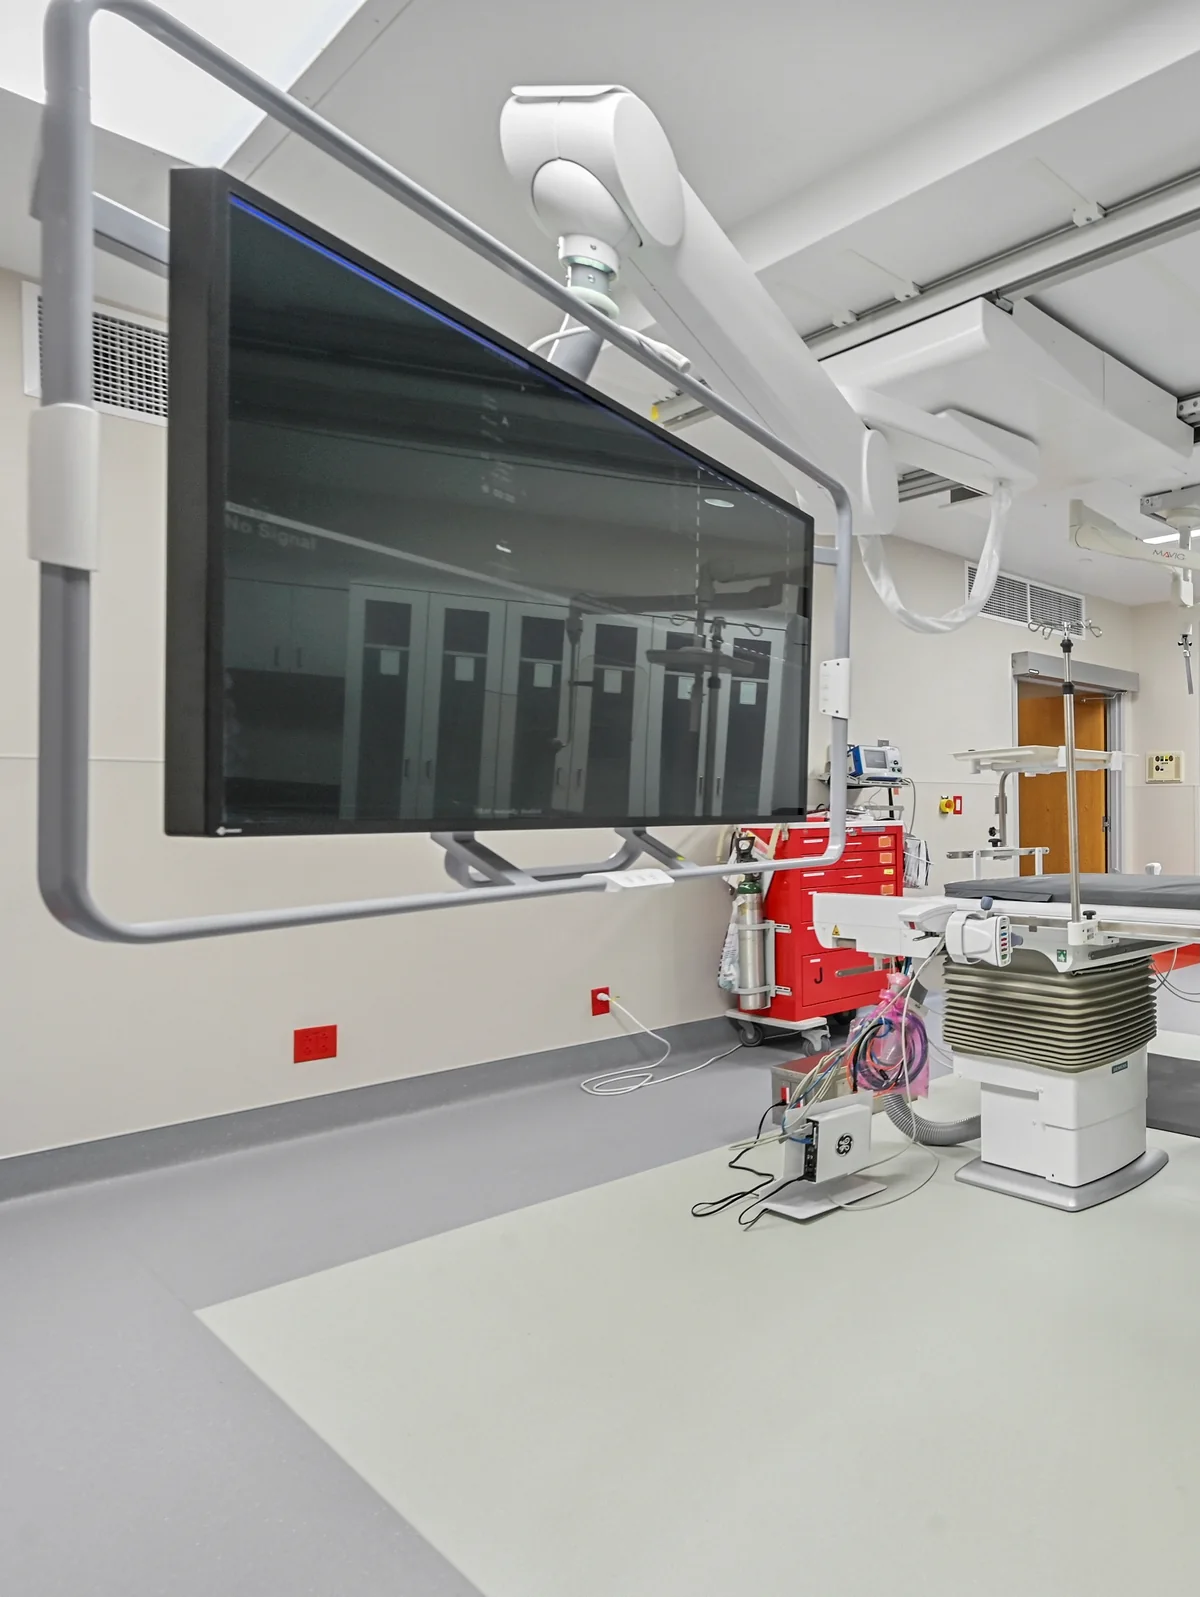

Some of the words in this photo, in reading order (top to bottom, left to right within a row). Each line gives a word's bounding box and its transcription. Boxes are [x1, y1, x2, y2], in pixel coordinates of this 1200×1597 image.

[224, 513, 252, 534] No
[258, 523, 316, 552] Signal
[1153, 549, 1185, 561] MAVIG
[814, 966, 823, 984] J
